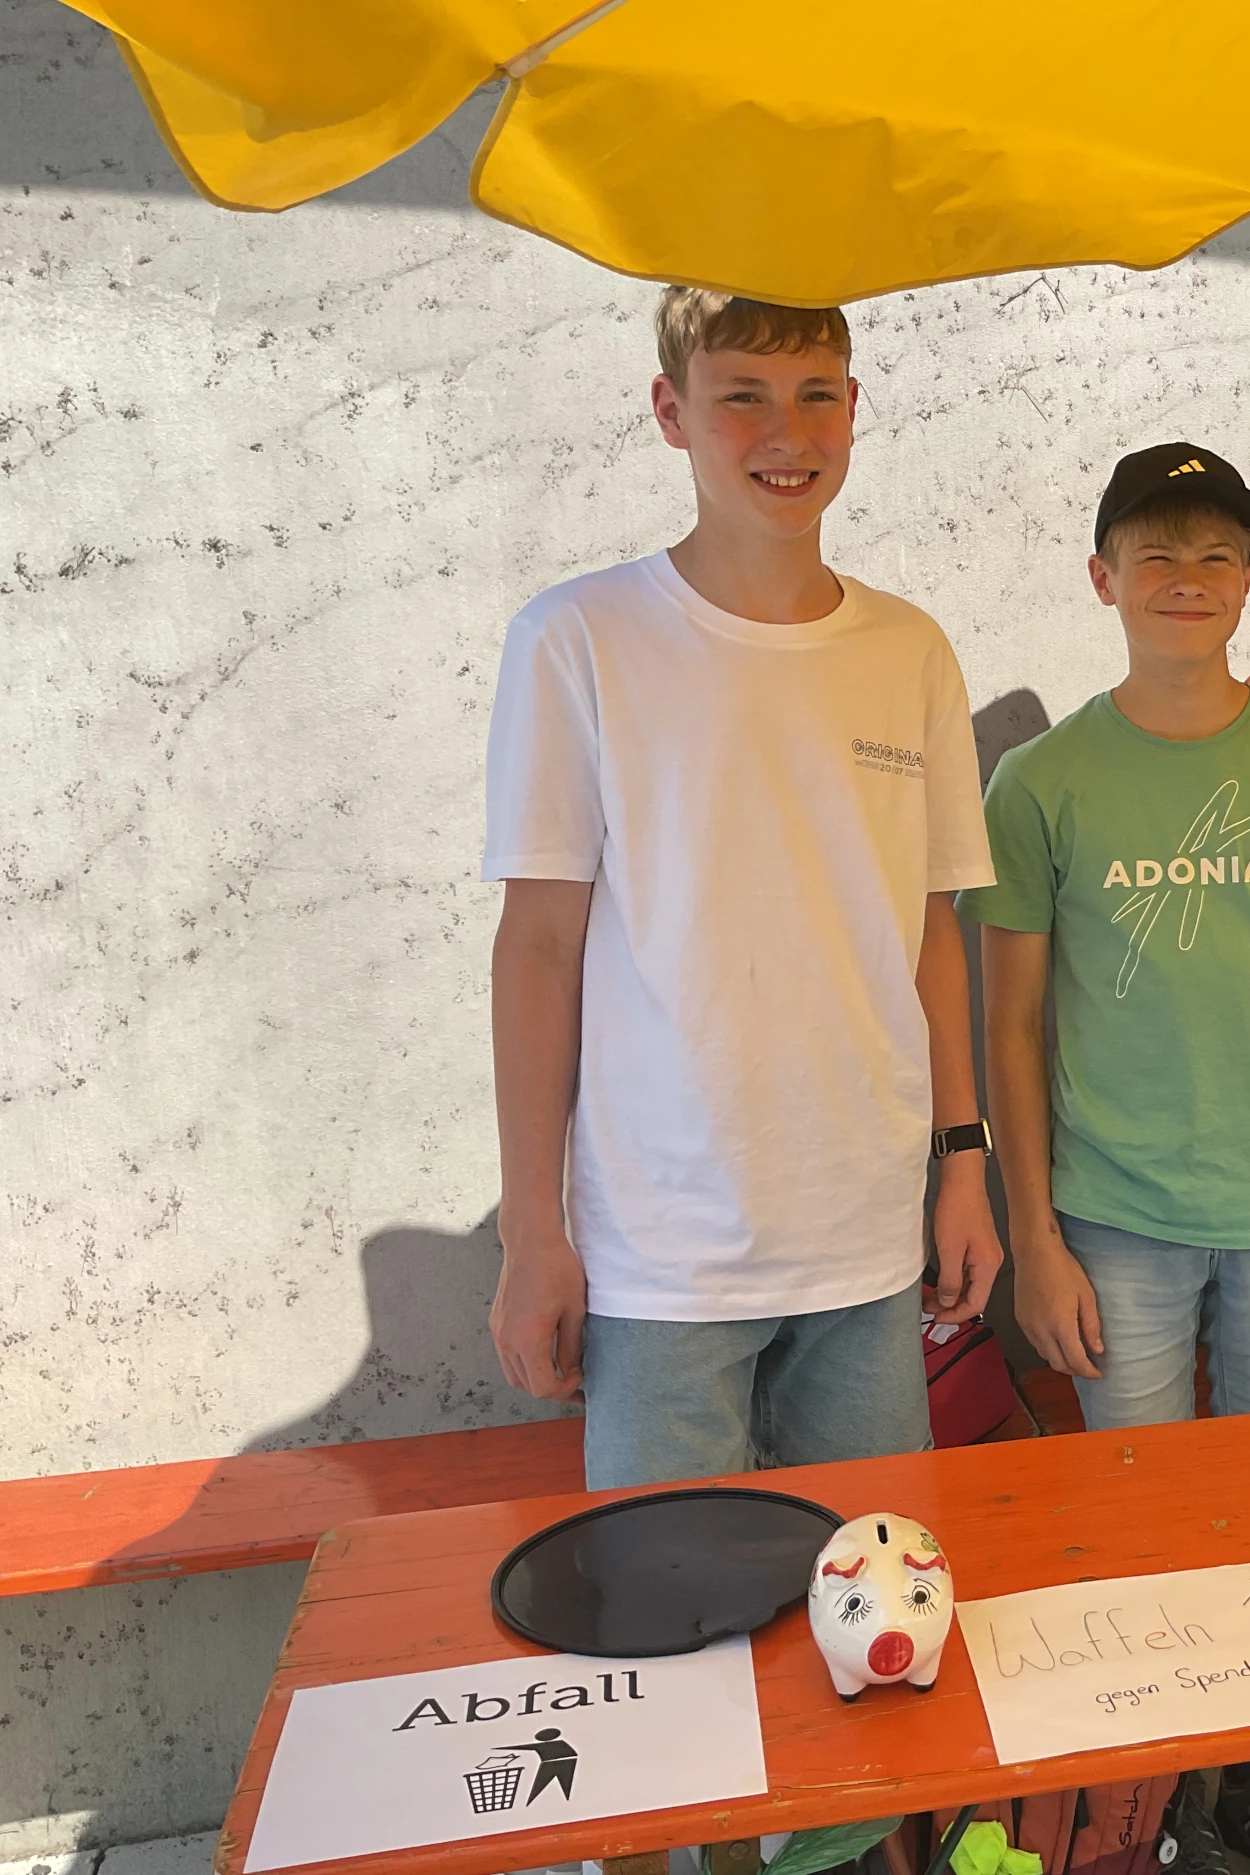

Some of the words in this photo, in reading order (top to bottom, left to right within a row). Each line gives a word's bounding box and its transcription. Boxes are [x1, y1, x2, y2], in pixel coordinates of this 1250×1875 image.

[989, 1603, 1215, 1678] Waffeln
[391, 1669, 646, 1732] Abfall
[1095, 1682, 1160, 1714] gegen
